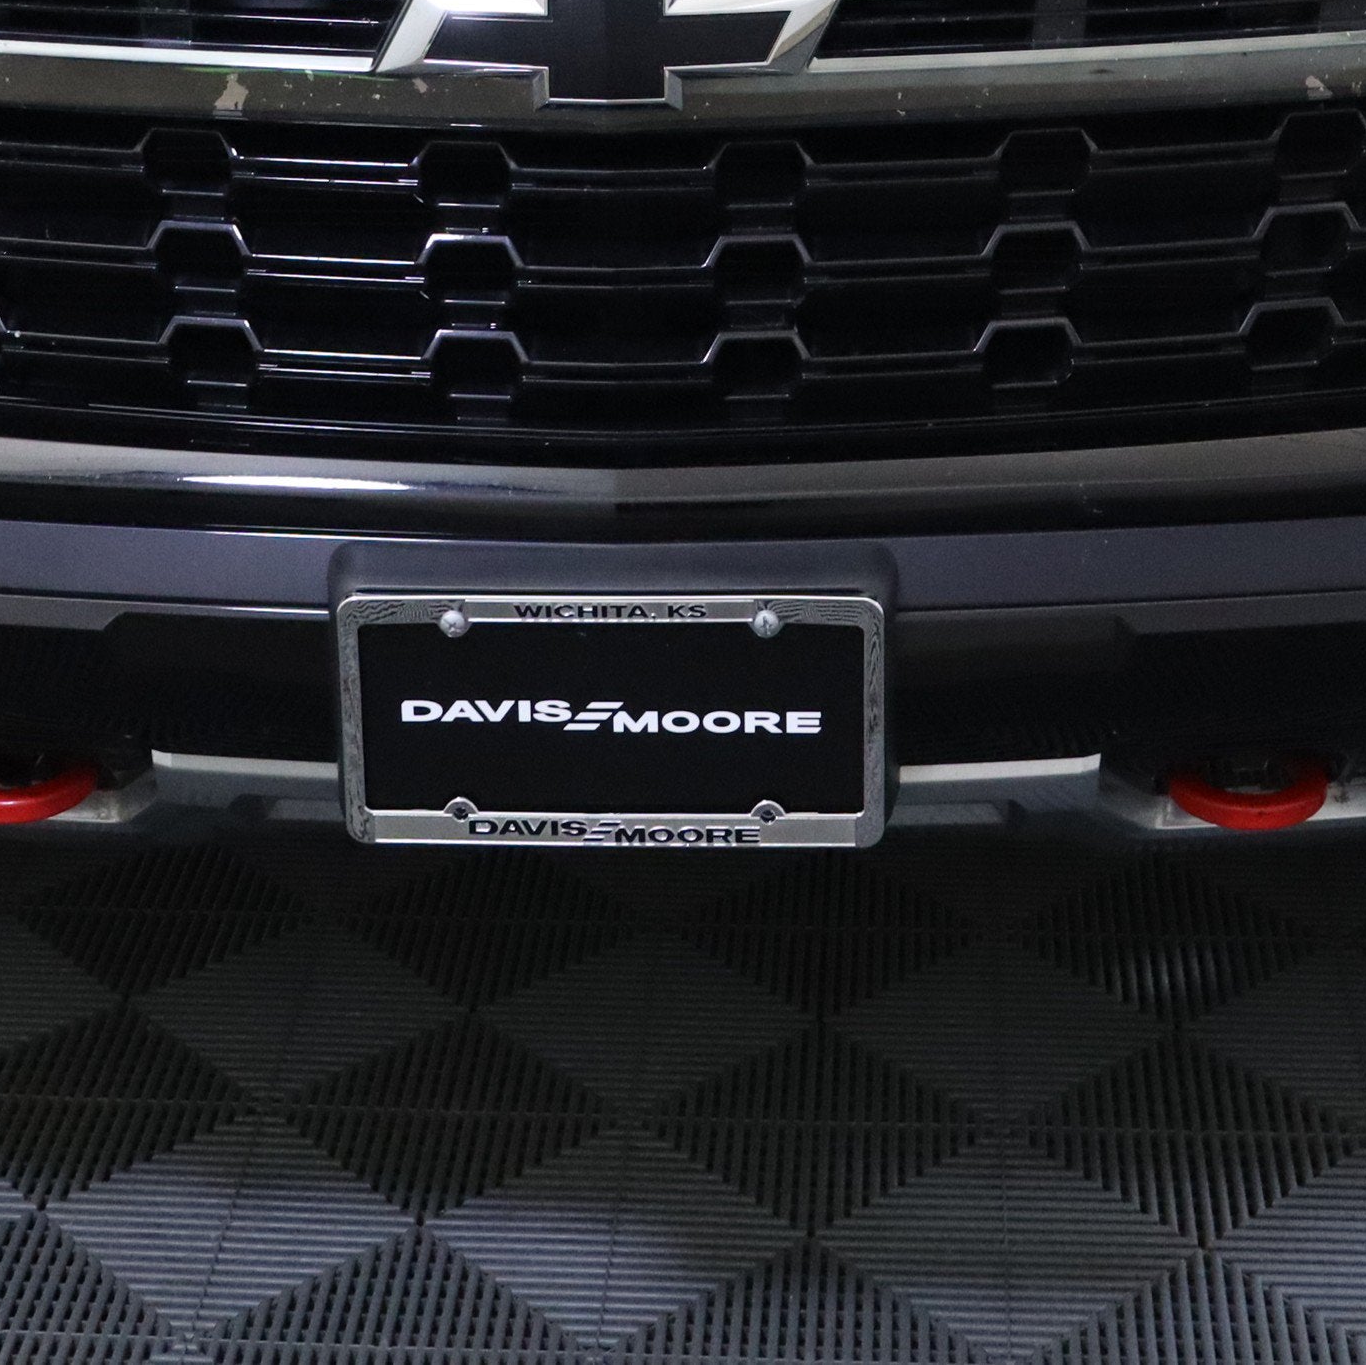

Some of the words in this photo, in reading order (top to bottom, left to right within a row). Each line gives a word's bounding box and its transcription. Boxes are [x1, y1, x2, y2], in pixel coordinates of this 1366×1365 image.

[667, 603, 707, 619] KS
[400, 699, 573, 723] DAVIS
[612, 710, 822, 734] MOORE
[468, 818, 588, 836] DAVIS
[614, 825, 761, 844] MOORE
